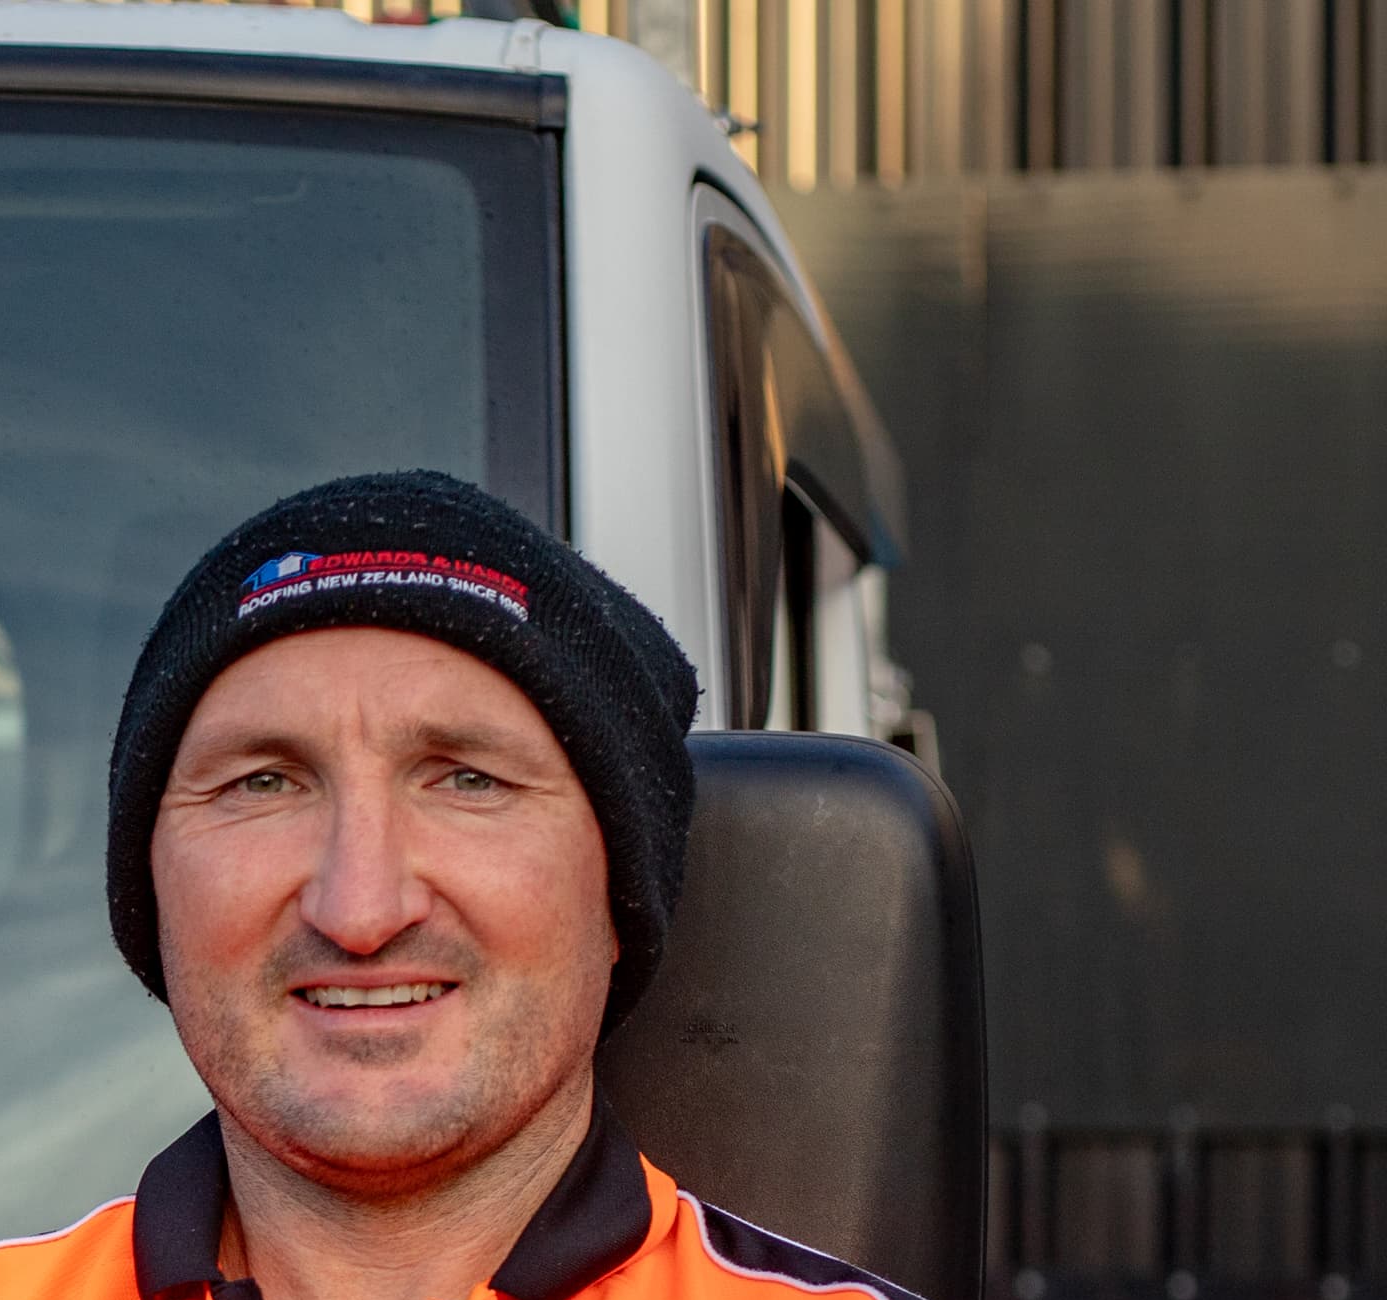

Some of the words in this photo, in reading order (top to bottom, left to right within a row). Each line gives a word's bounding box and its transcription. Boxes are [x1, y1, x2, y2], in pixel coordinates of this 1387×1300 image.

[308, 551, 427, 571] EDWARDS
[433, 556, 451, 571] &
[238, 581, 312, 619] ROOFING
[317, 572, 361, 591] NEW
[361, 571, 444, 587] ZEALAND
[446, 577, 497, 603] SINCE
